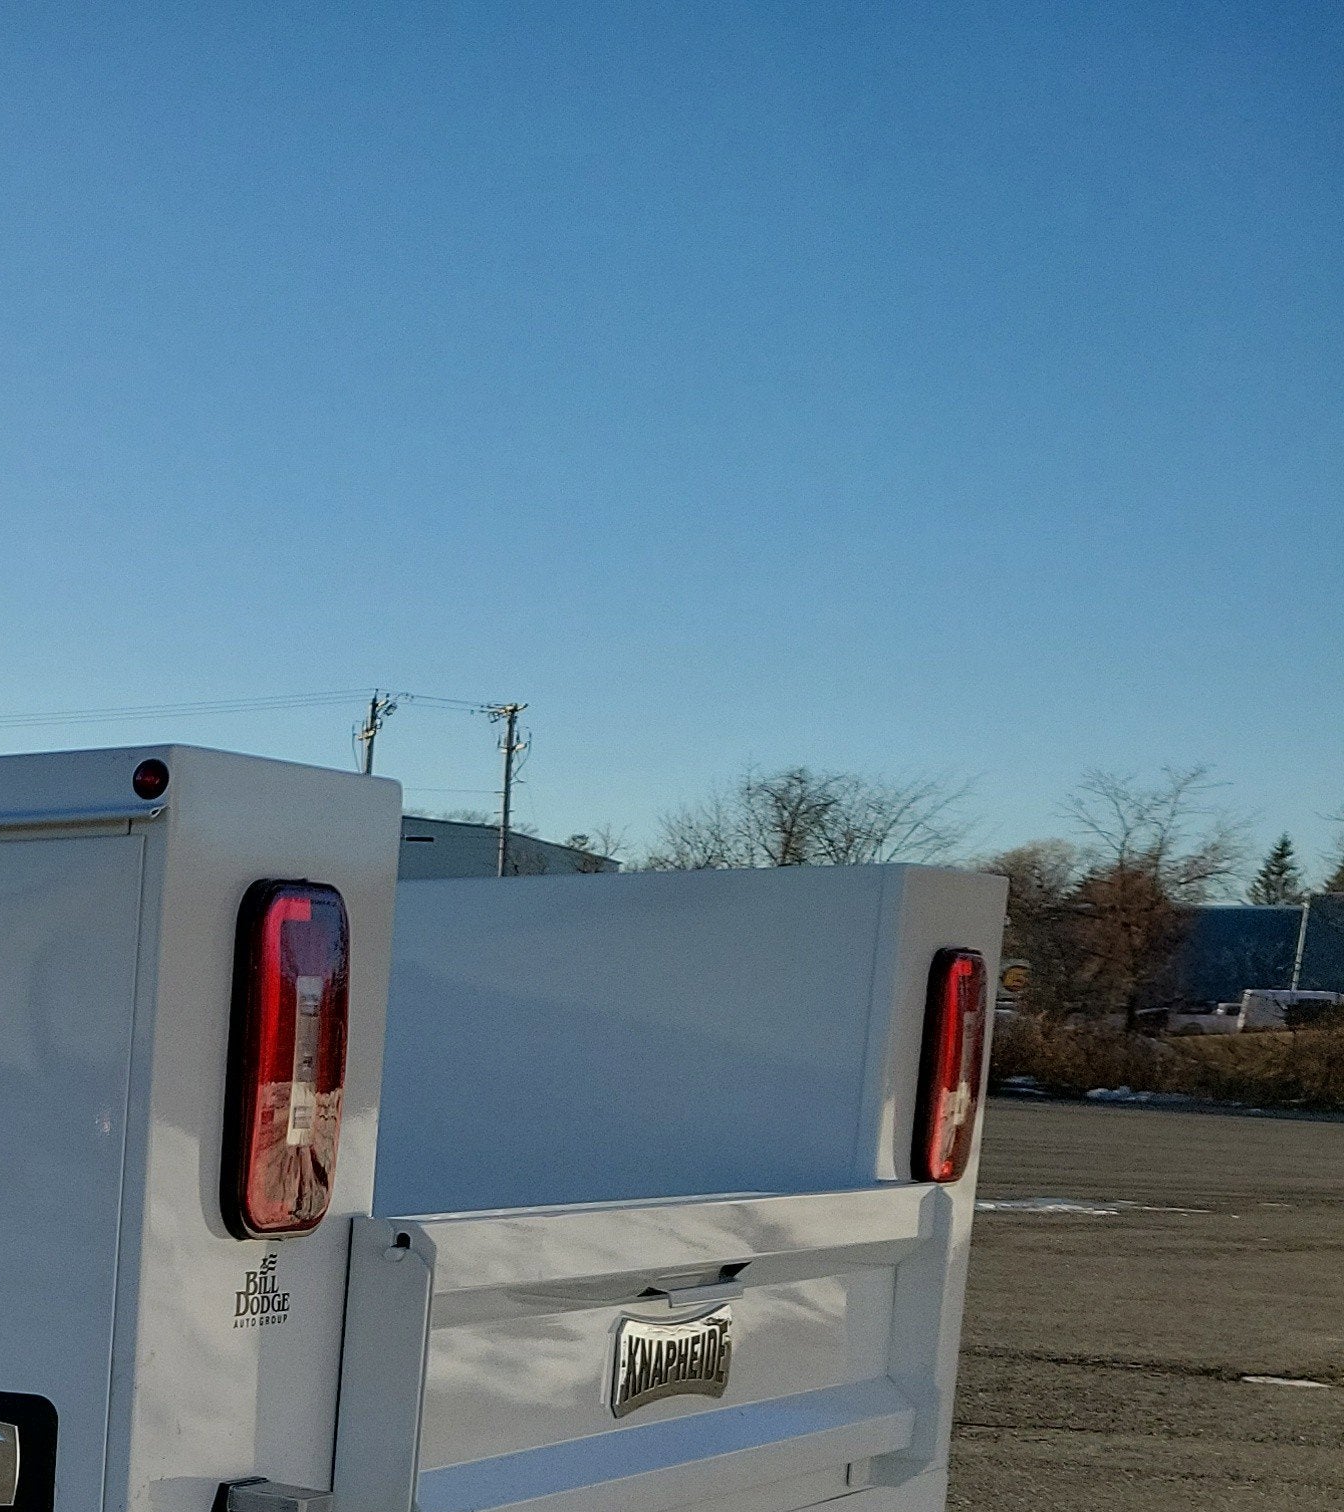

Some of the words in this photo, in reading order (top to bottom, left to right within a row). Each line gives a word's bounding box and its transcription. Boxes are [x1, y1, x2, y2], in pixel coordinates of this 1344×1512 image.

[245, 1271, 280, 1296] BILL
[234, 1291, 290, 1317] DODGE
[233, 1318, 256, 1329] AUTO
[259, 1314, 288, 1326] GROUP
[620, 1319, 730, 1402] KNAPHEIDE
